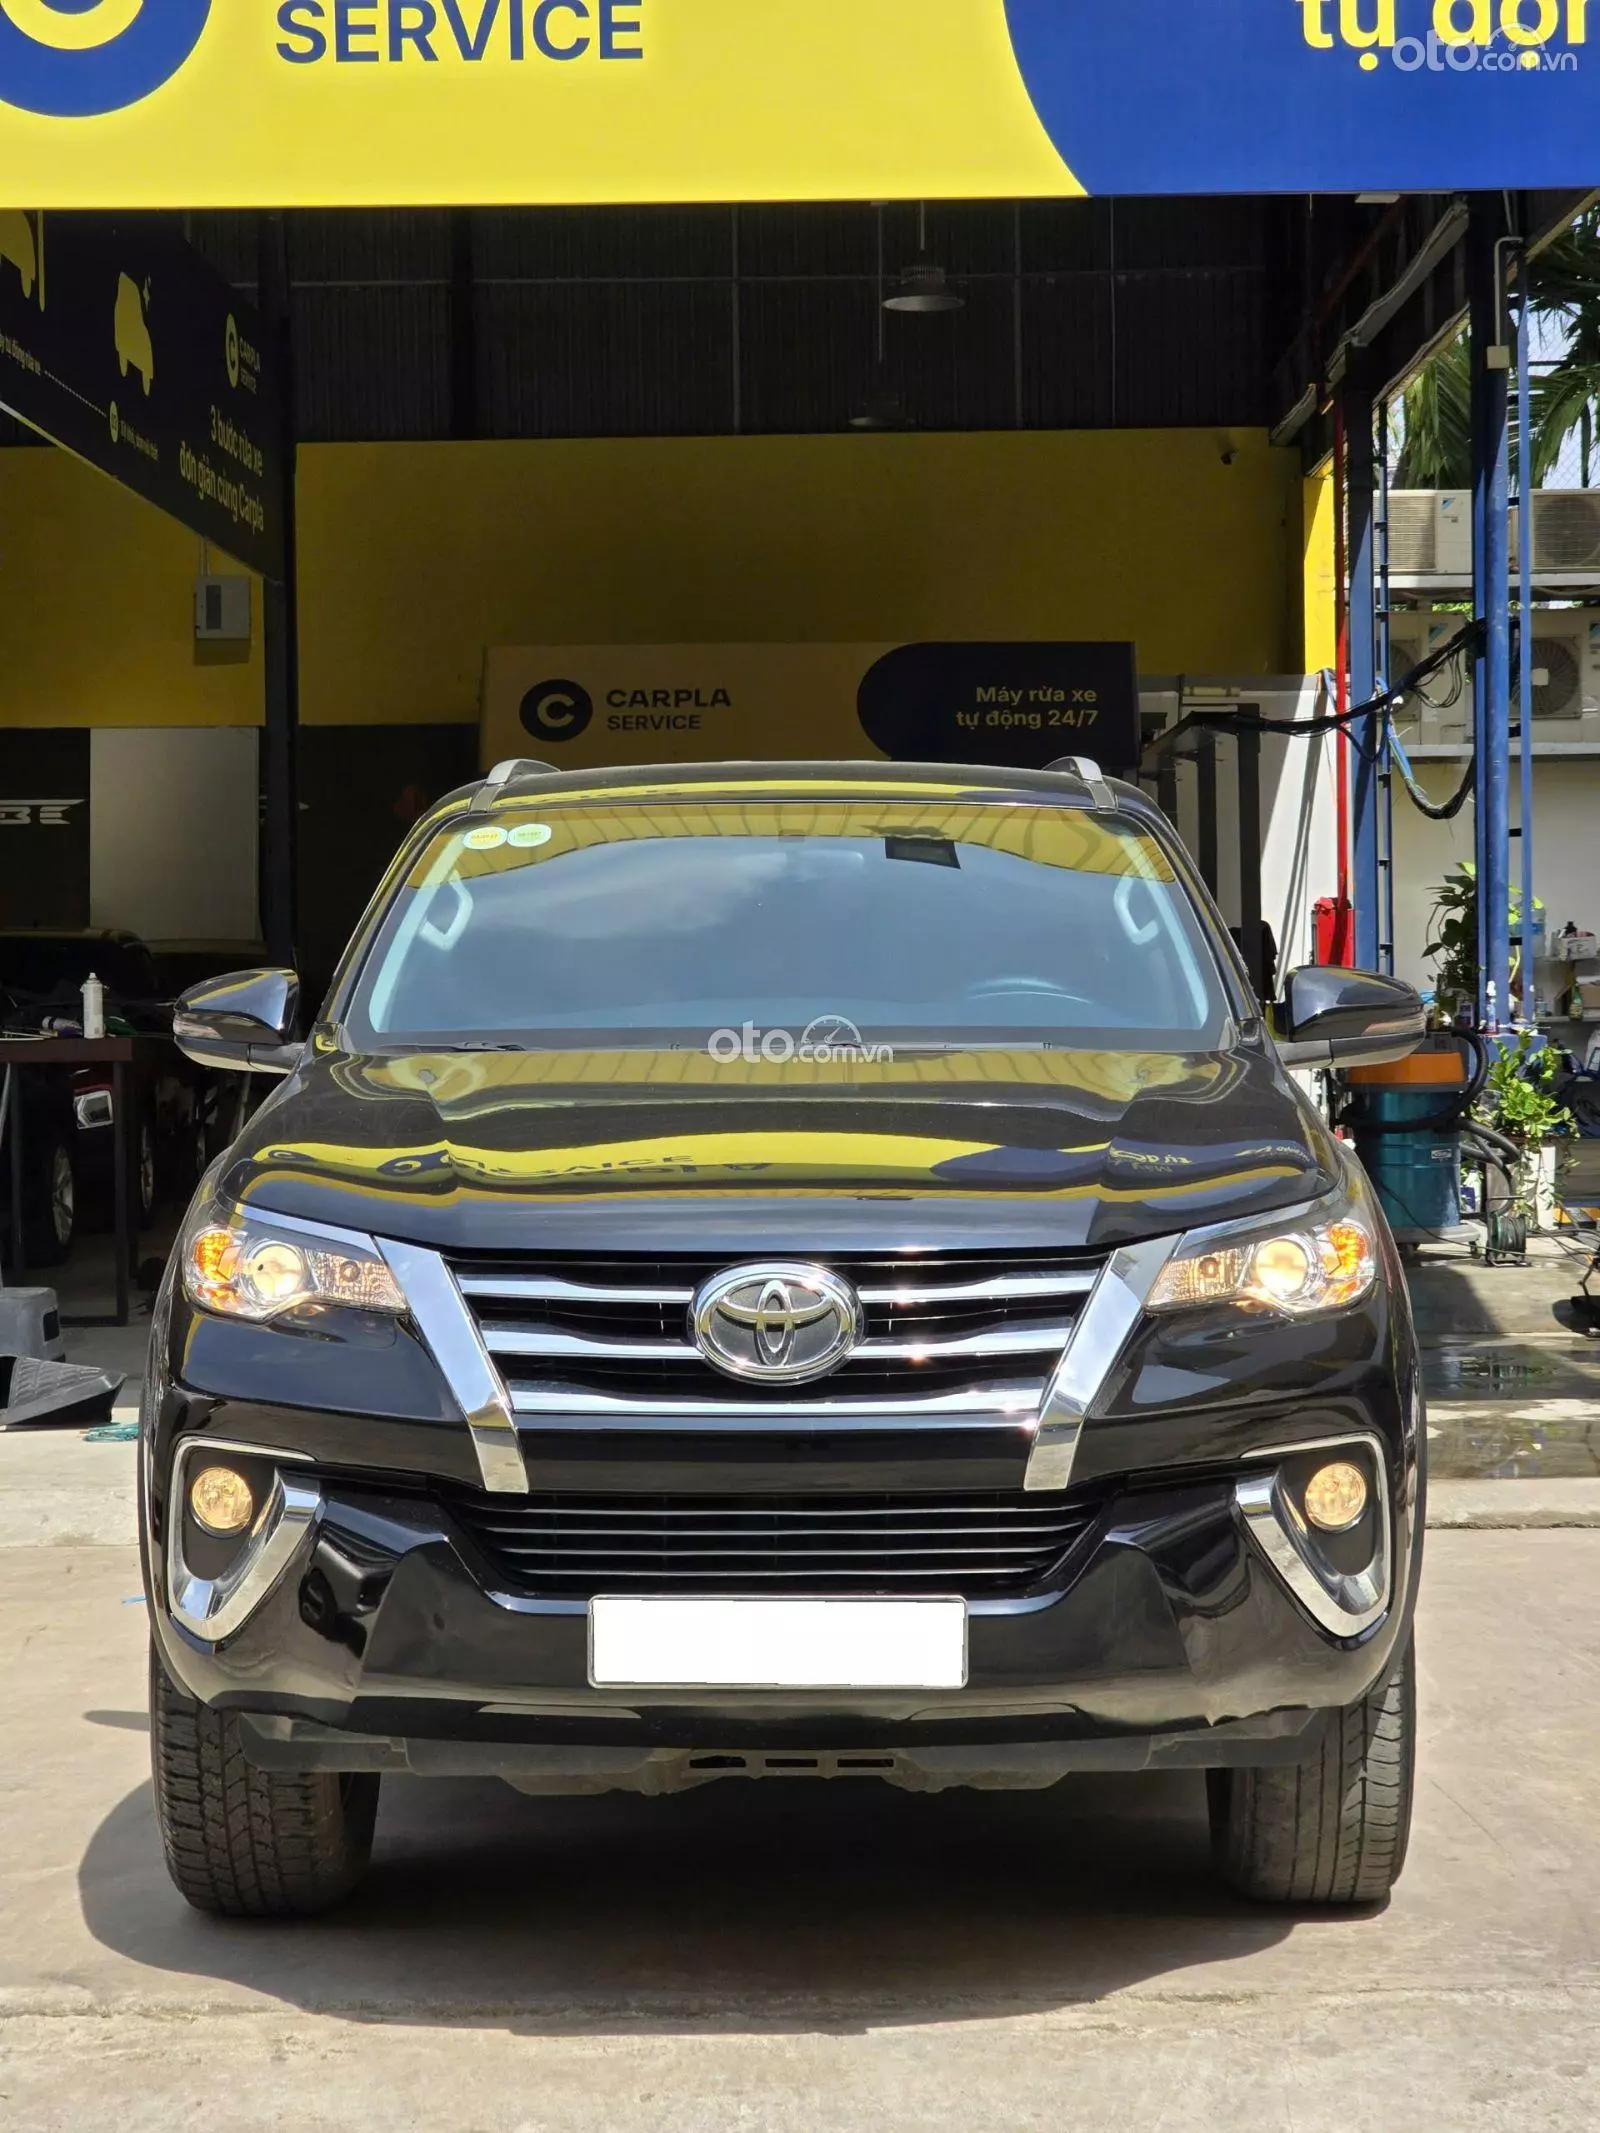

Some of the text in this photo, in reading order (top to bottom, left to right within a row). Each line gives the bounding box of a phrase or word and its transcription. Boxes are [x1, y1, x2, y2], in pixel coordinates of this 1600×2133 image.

[275, 0, 644, 64] SERVICE
[606, 688, 732, 708] CARPLA
[975, 683, 1098, 706] Máy rửa xe
[607, 714, 701, 731] SERVICE
[955, 708, 1099, 731] tự động 24/7
